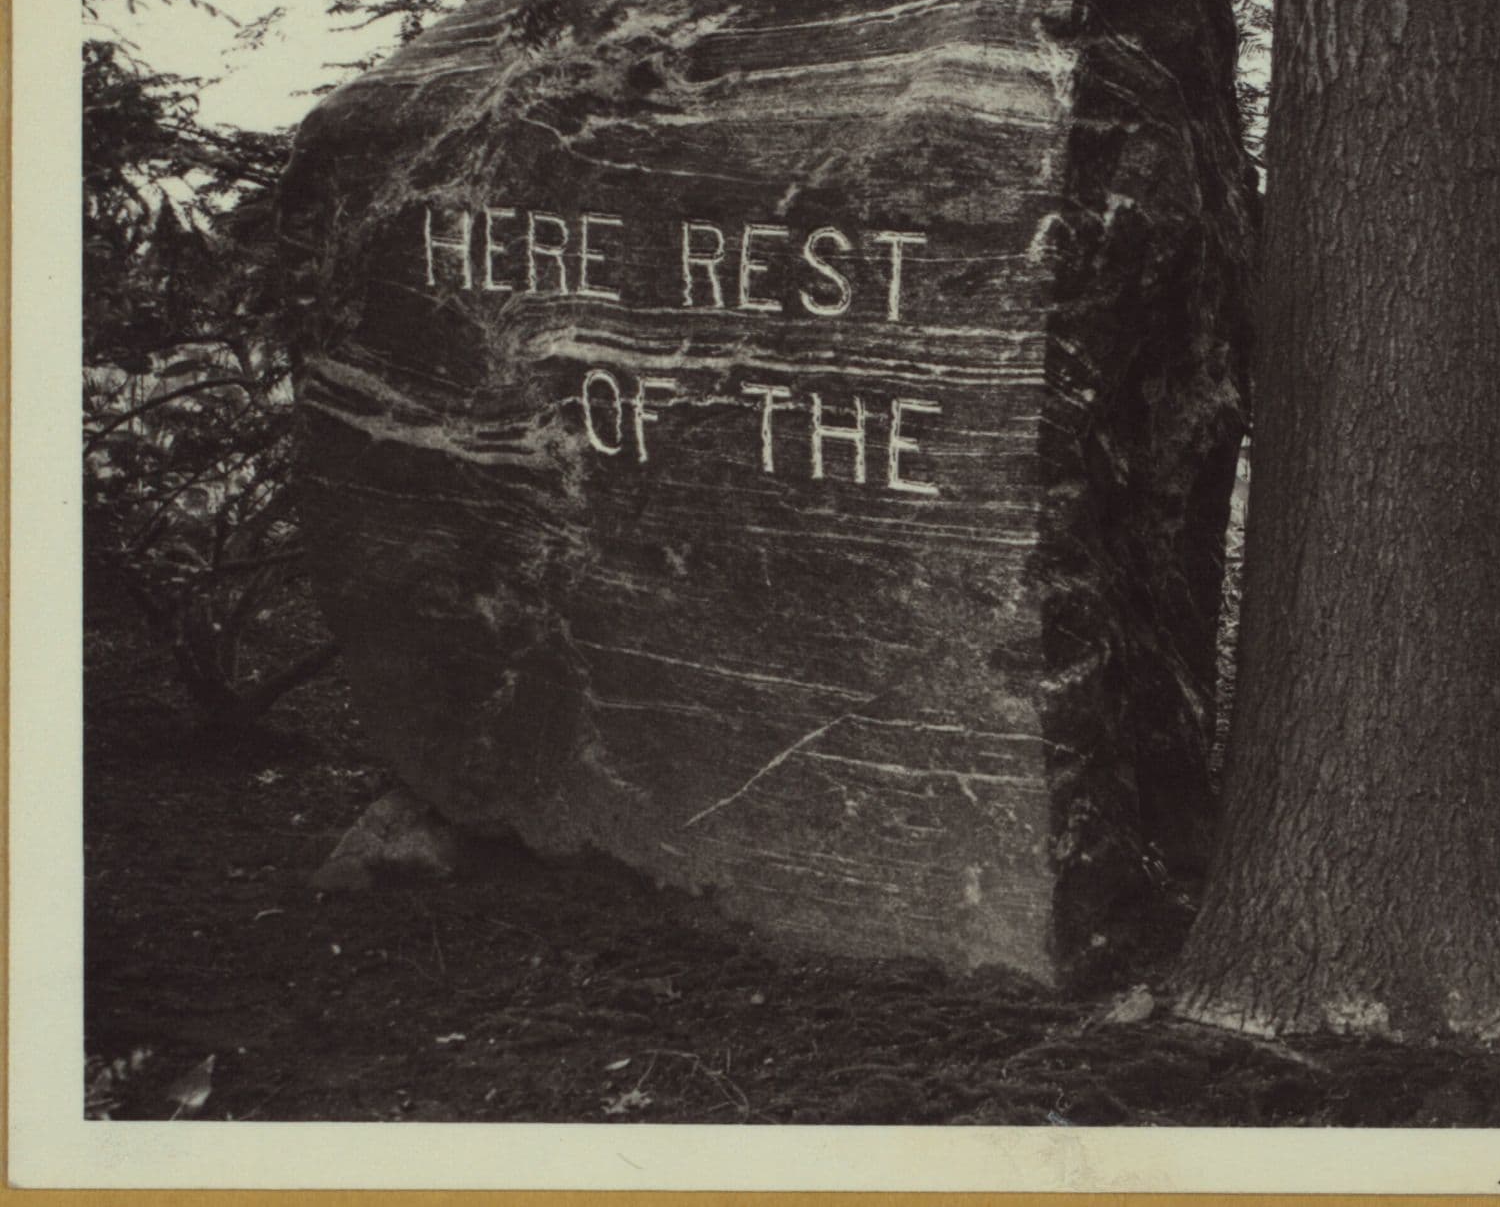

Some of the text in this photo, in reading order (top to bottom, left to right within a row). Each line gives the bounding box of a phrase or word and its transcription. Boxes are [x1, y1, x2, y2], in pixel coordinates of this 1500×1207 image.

[424, 207, 927, 321] HERE REST
[582, 369, 942, 494] OF THE
